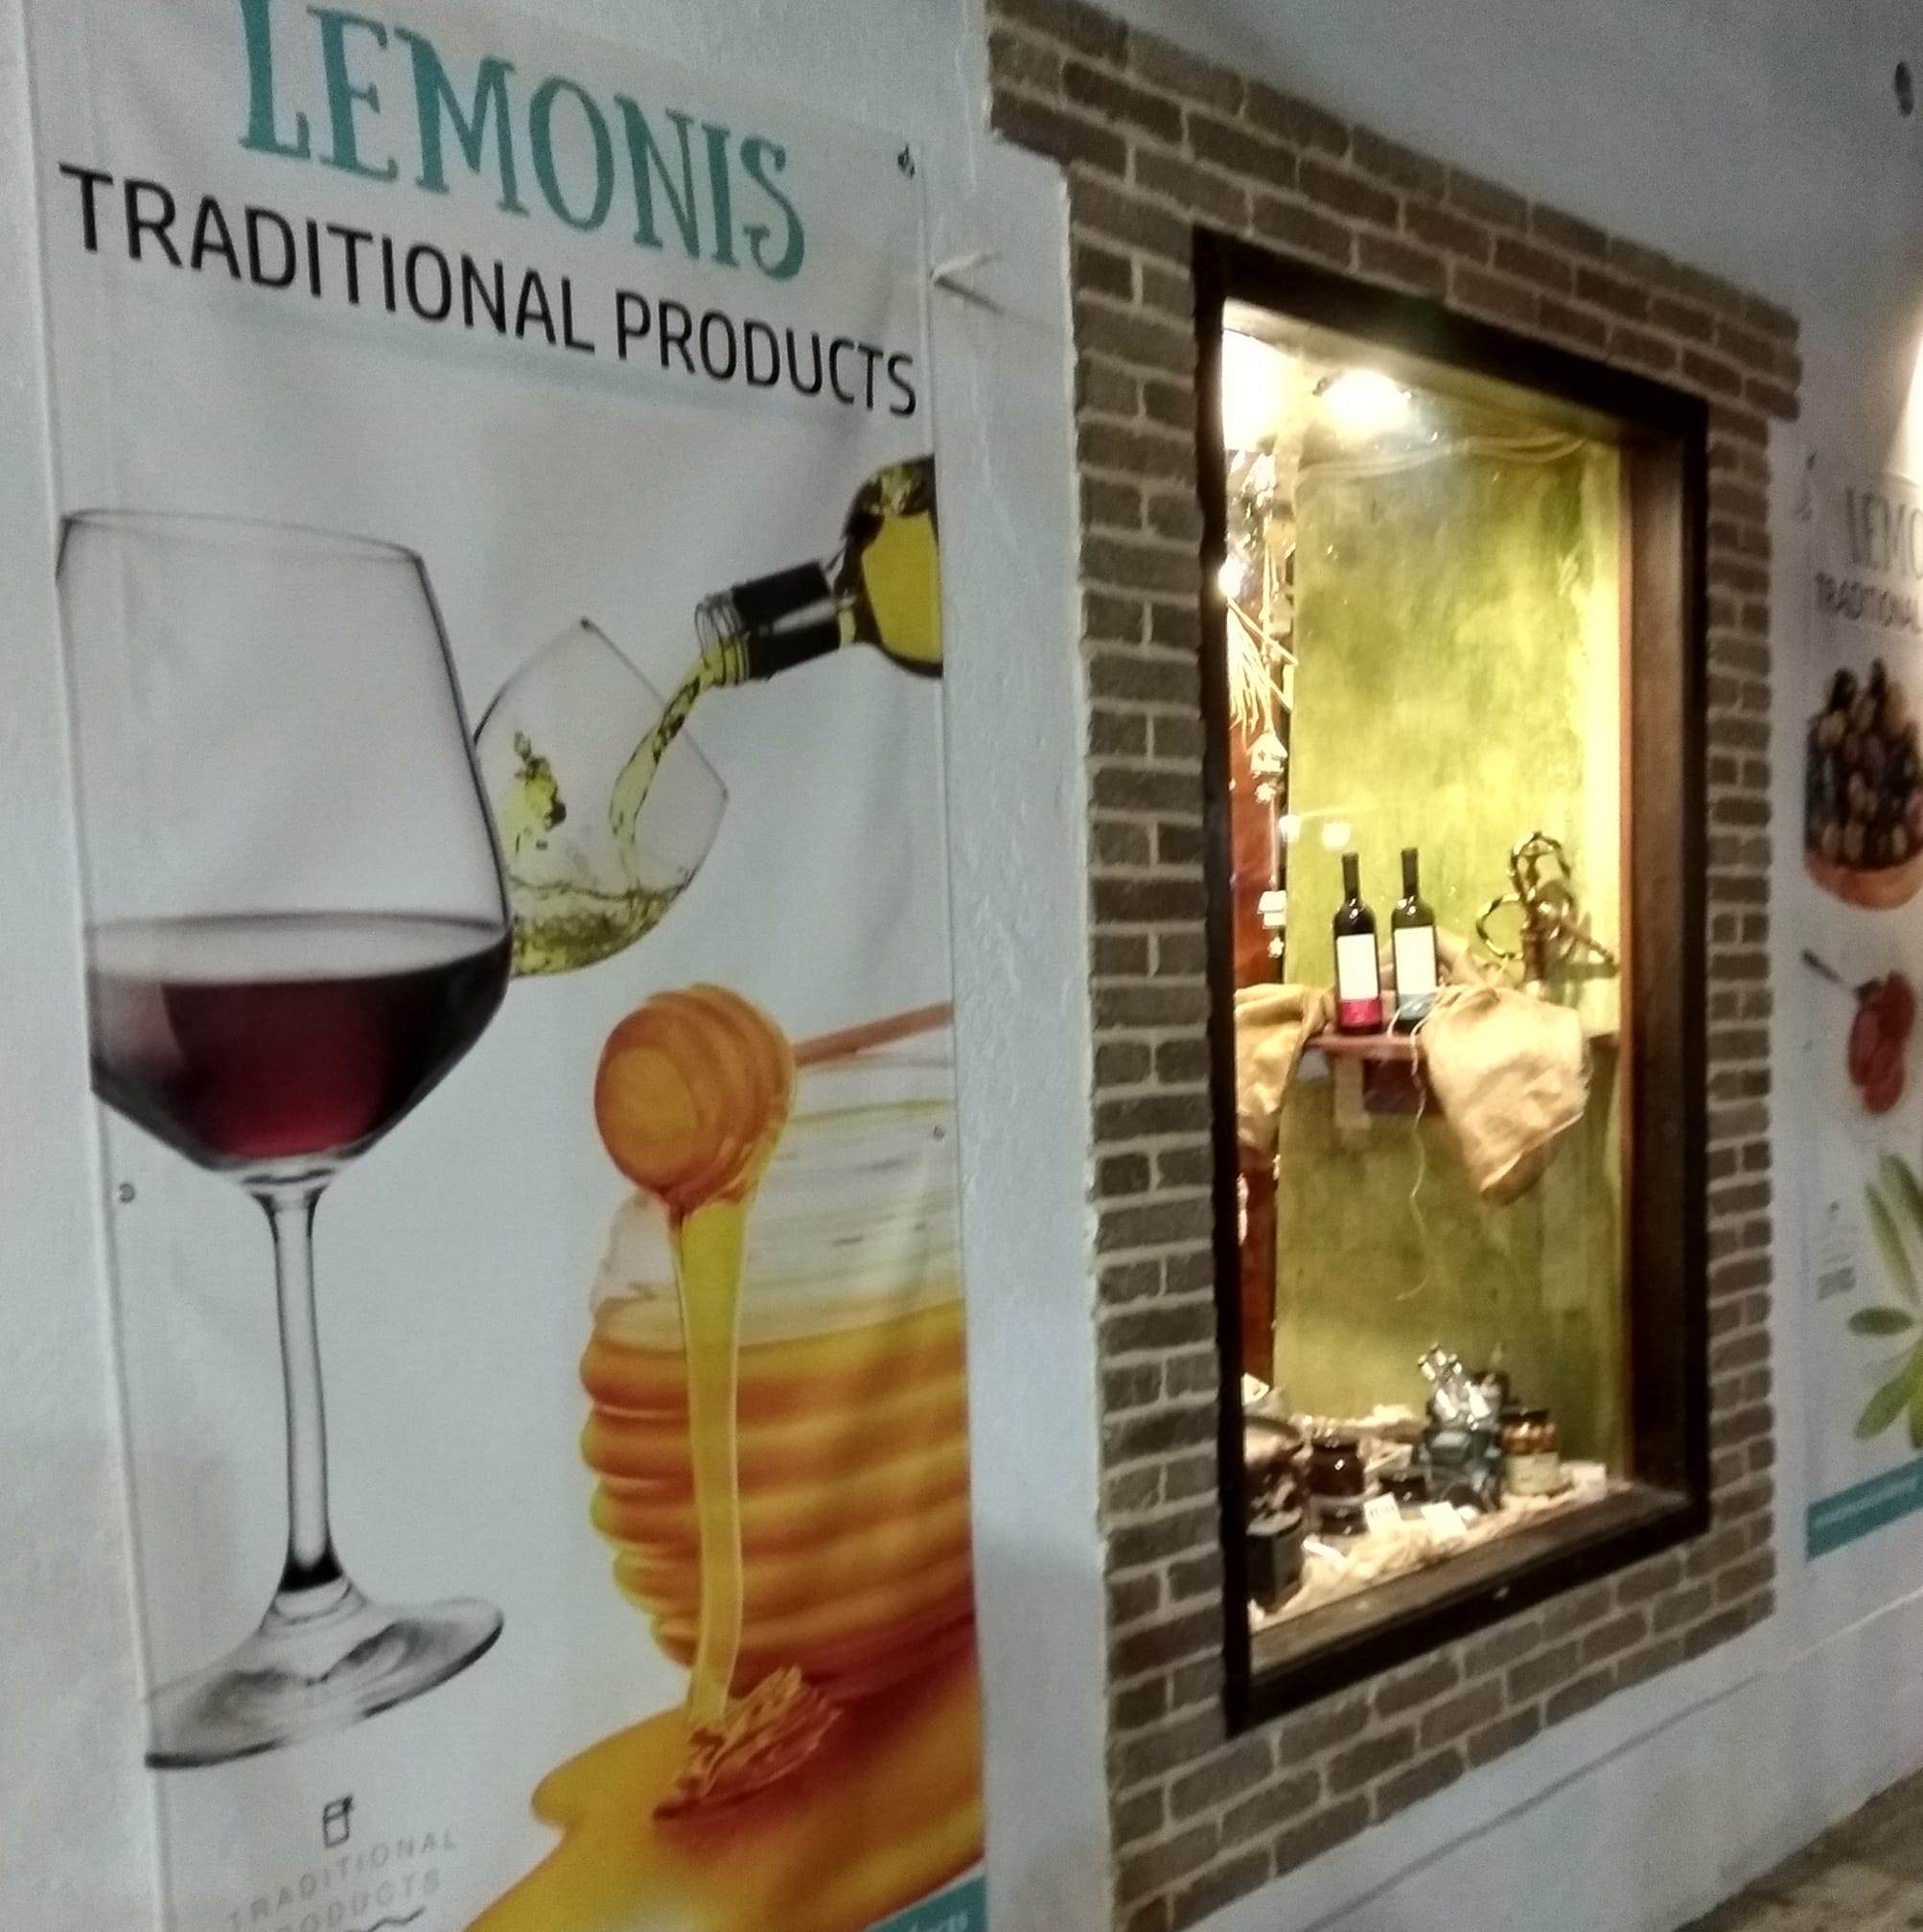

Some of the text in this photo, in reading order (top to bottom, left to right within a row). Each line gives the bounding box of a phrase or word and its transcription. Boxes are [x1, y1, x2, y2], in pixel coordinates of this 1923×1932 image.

[238, 0, 806, 280] LEMONIS
[58, 161, 917, 418] TRADITIONAL PRODUCTS
